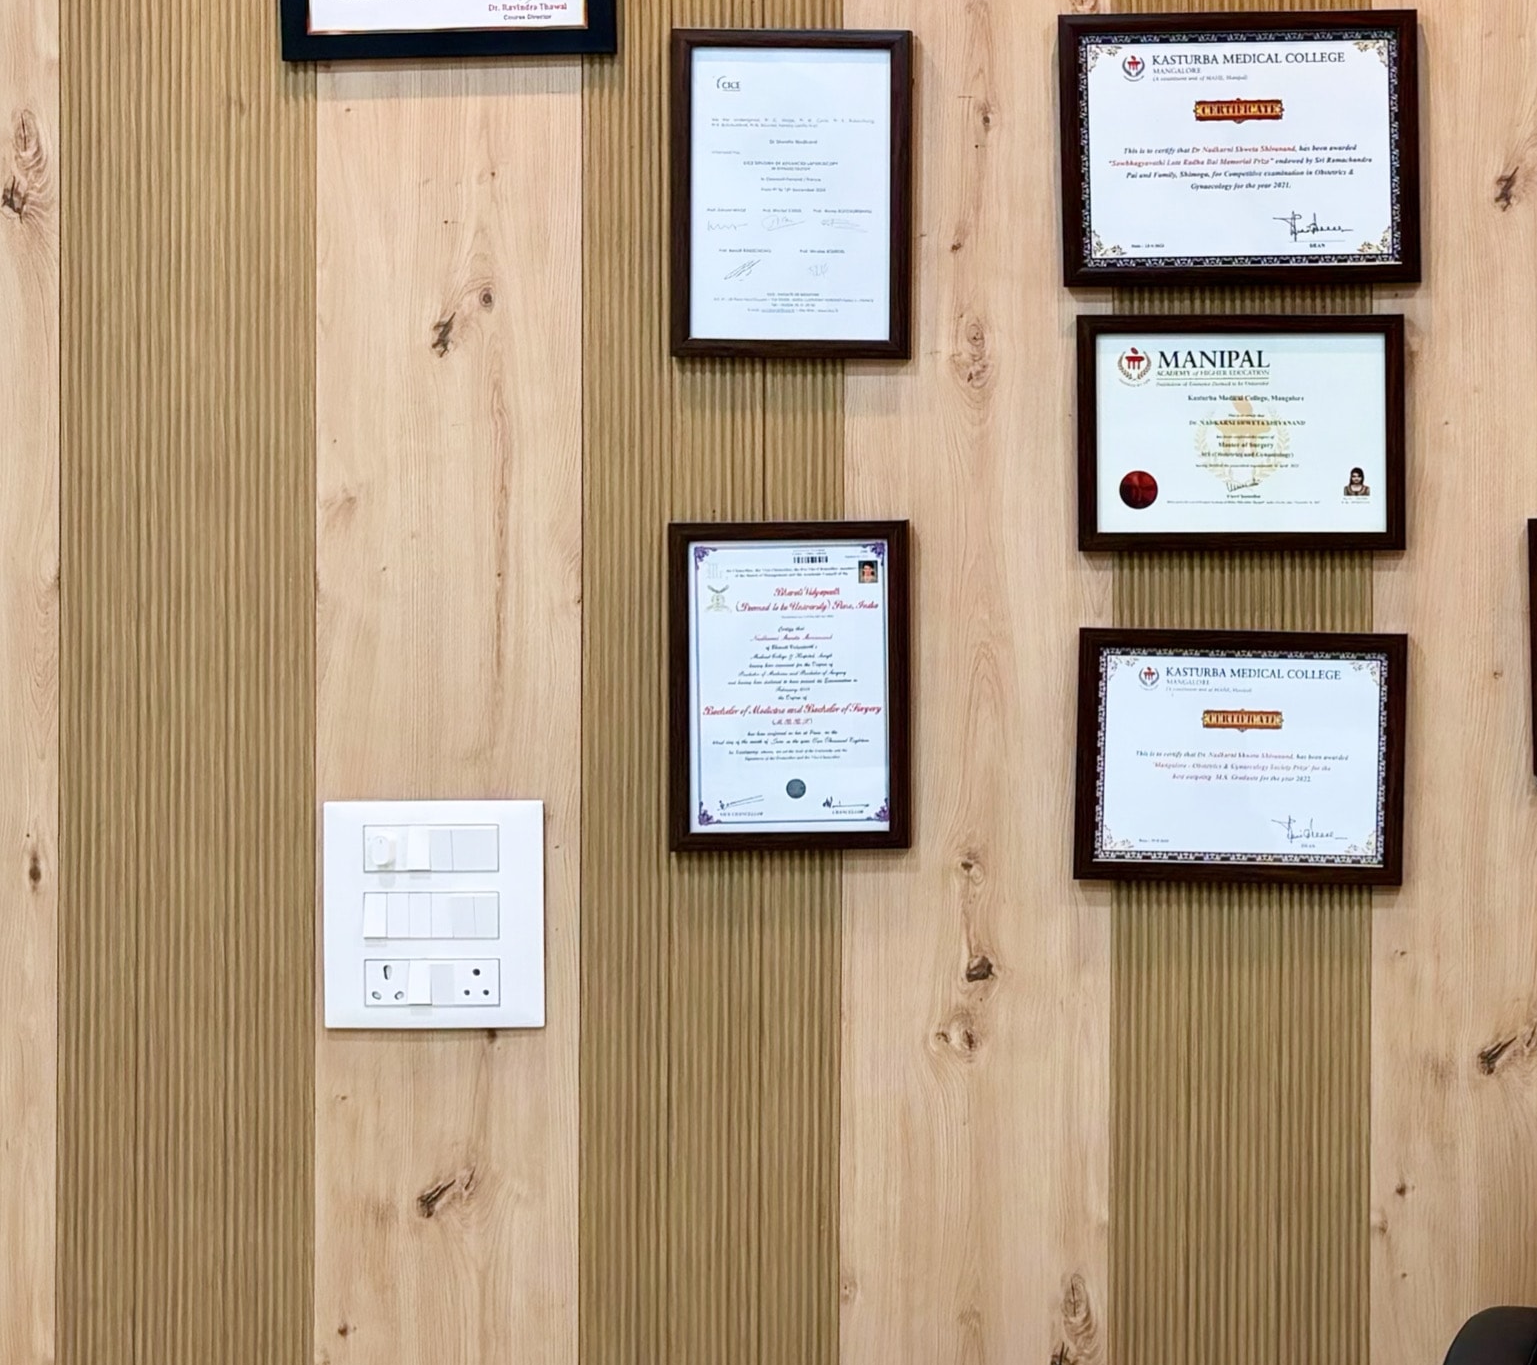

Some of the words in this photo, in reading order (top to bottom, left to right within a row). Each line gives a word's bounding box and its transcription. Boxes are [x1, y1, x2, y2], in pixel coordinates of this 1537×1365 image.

[1152, 54, 1219, 66] KASTURBA
[1223, 54, 1282, 64] MEDICAL
[1285, 52, 1346, 63] COLLEGE
[1158, 350, 1270, 368] MANIPAL
[1166, 667, 1226, 678] KASTURBA
[1230, 669, 1284, 679] MEDICAL
[1287, 669, 1341, 680] COLLEGE
